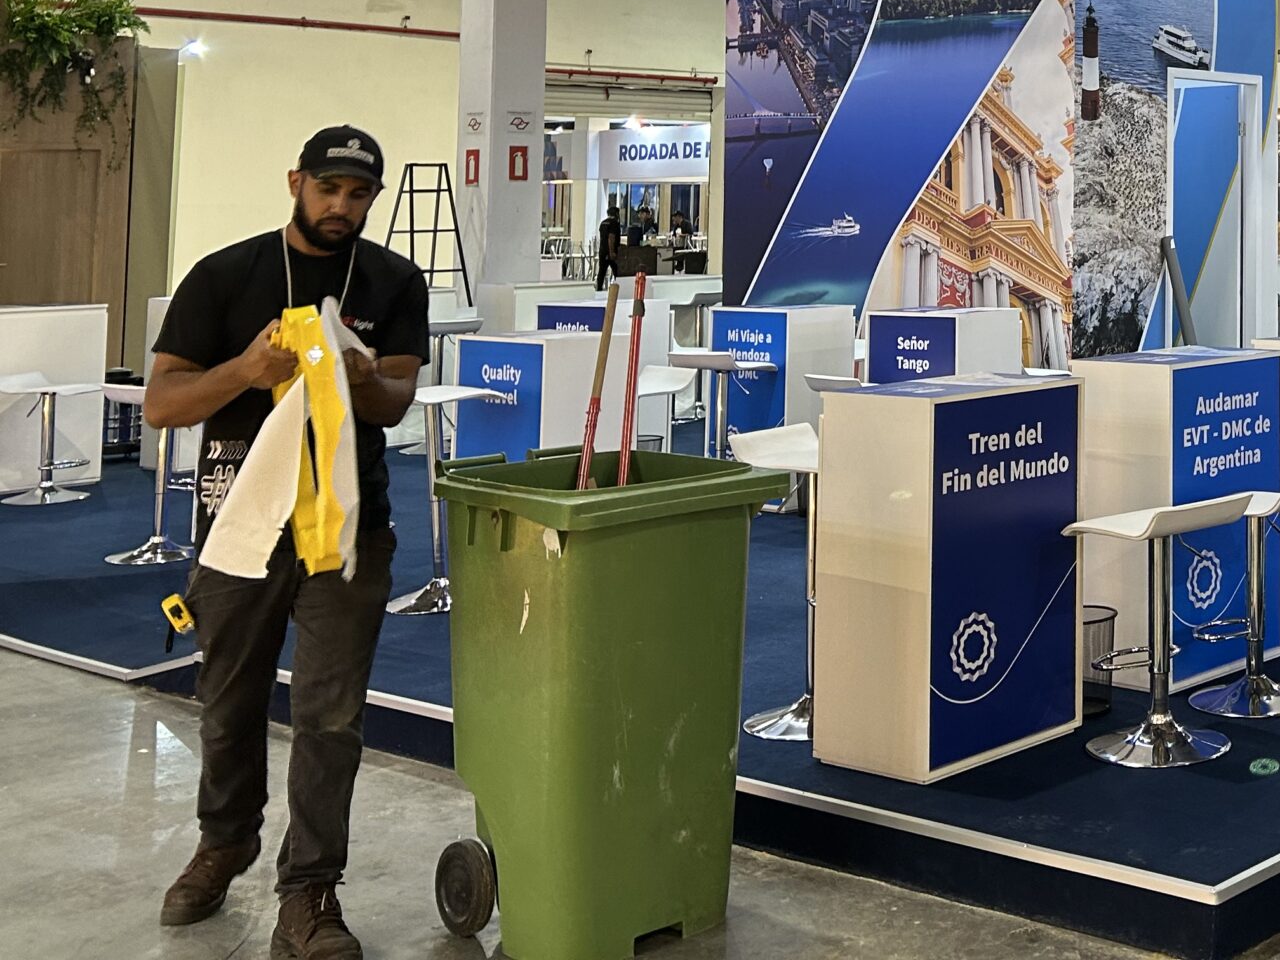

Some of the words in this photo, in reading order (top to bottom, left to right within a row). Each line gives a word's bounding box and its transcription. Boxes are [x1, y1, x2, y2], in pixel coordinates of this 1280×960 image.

[619, 142, 679, 161] RODADA
[683, 141, 702, 159] DE
[727, 328, 739, 343] Mi
[740, 328, 764, 346] Viaje
[766, 333, 772, 344] a
[897, 336, 930, 352] Señor
[481, 364, 522, 385] Quality
[896, 355, 930, 372] Tango
[1195, 391, 1259, 416] Audamar
[968, 432, 1010, 455] Tren
[1014, 421, 1043, 448] del
[1183, 424, 1210, 448] EVT
[1221, 417, 1252, 441] DMC
[1254, 414, 1271, 435] de
[1193, 445, 1261, 477] Argentina
[942, 468, 972, 495] Fin
[976, 461, 1006, 489] del
[1010, 451, 1070, 482] Mundo
